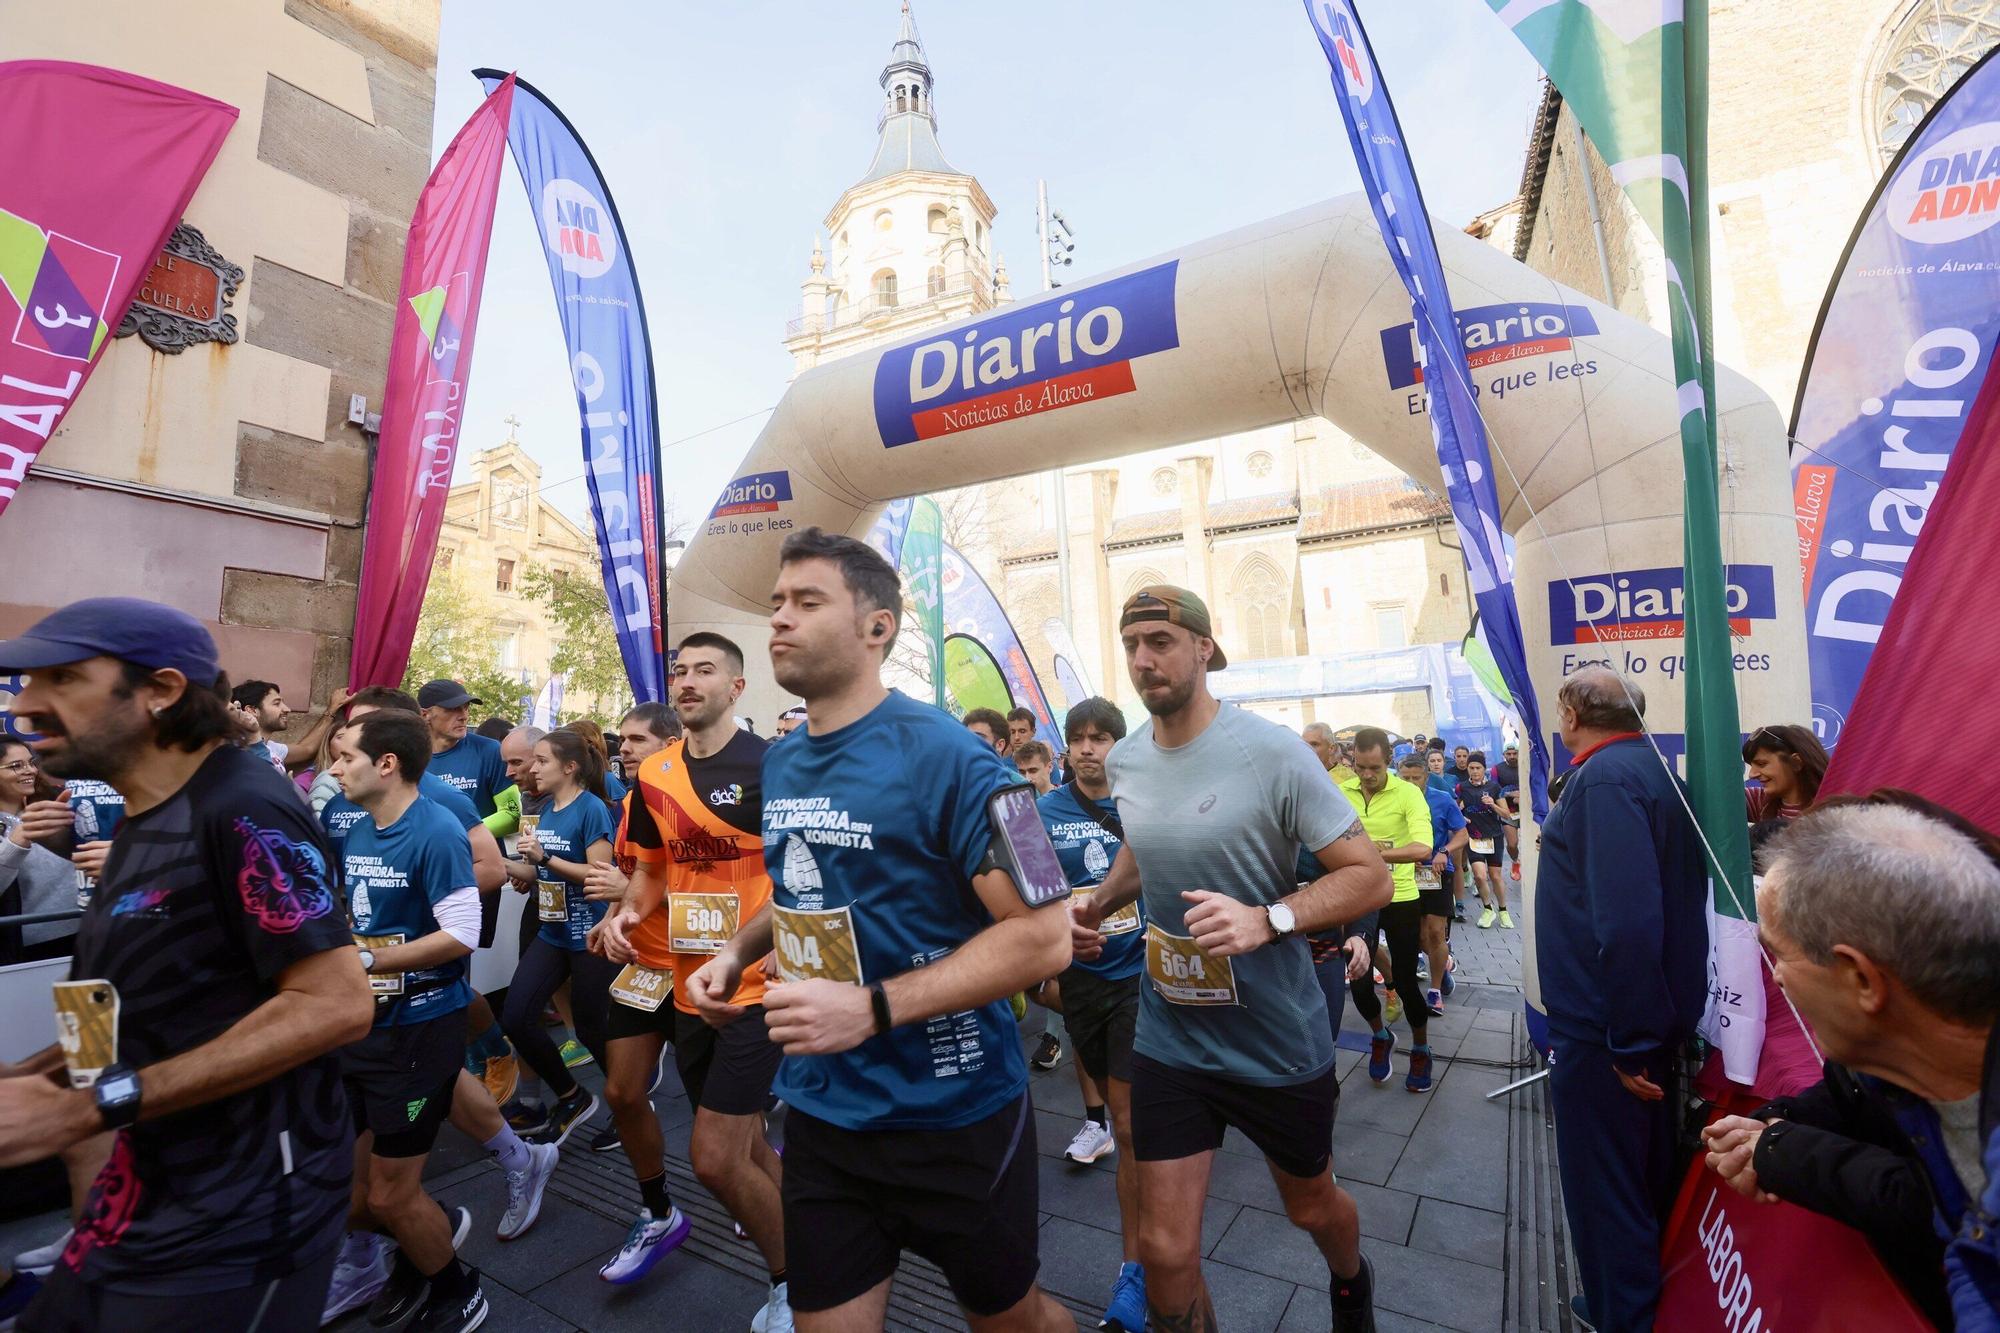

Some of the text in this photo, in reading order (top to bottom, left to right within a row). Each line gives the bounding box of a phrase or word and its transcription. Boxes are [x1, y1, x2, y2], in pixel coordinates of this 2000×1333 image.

[1907, 180, 2000, 224] ADN
[1857, 263, 1912, 278] noticias
[1917, 263, 1935, 274] de
[139, 287, 209, 319] CUELAS
[909, 300, 1123, 404] Diario
[1488, 352, 1502, 364] de
[1504, 344, 1545, 359] Álava
[1490, 371, 1536, 399] que
[1548, 360, 1597, 381] lees
[942, 380, 1094, 432] Noticias de Álava
[719, 478, 776, 506] Diario
[708, 518, 793, 536] Eres lo que lees
[1574, 578, 1749, 623] Diaro
[1599, 625, 1654, 641] Noticias
[1658, 624, 1676, 638] de
[1625, 651, 1647, 673] lo
[1660, 655, 1685, 680] qu
[1733, 653, 1770, 671] ees
[773, 797, 831, 812] CONQUISTA
[768, 811, 850, 831] ALMENDRA
[851, 822, 873, 834] REN
[803, 829, 874, 850] KONKISTA
[368, 877, 410, 888] KONKISTA
[687, 909, 723, 932] 580
[1161, 948, 1206, 980] 564
